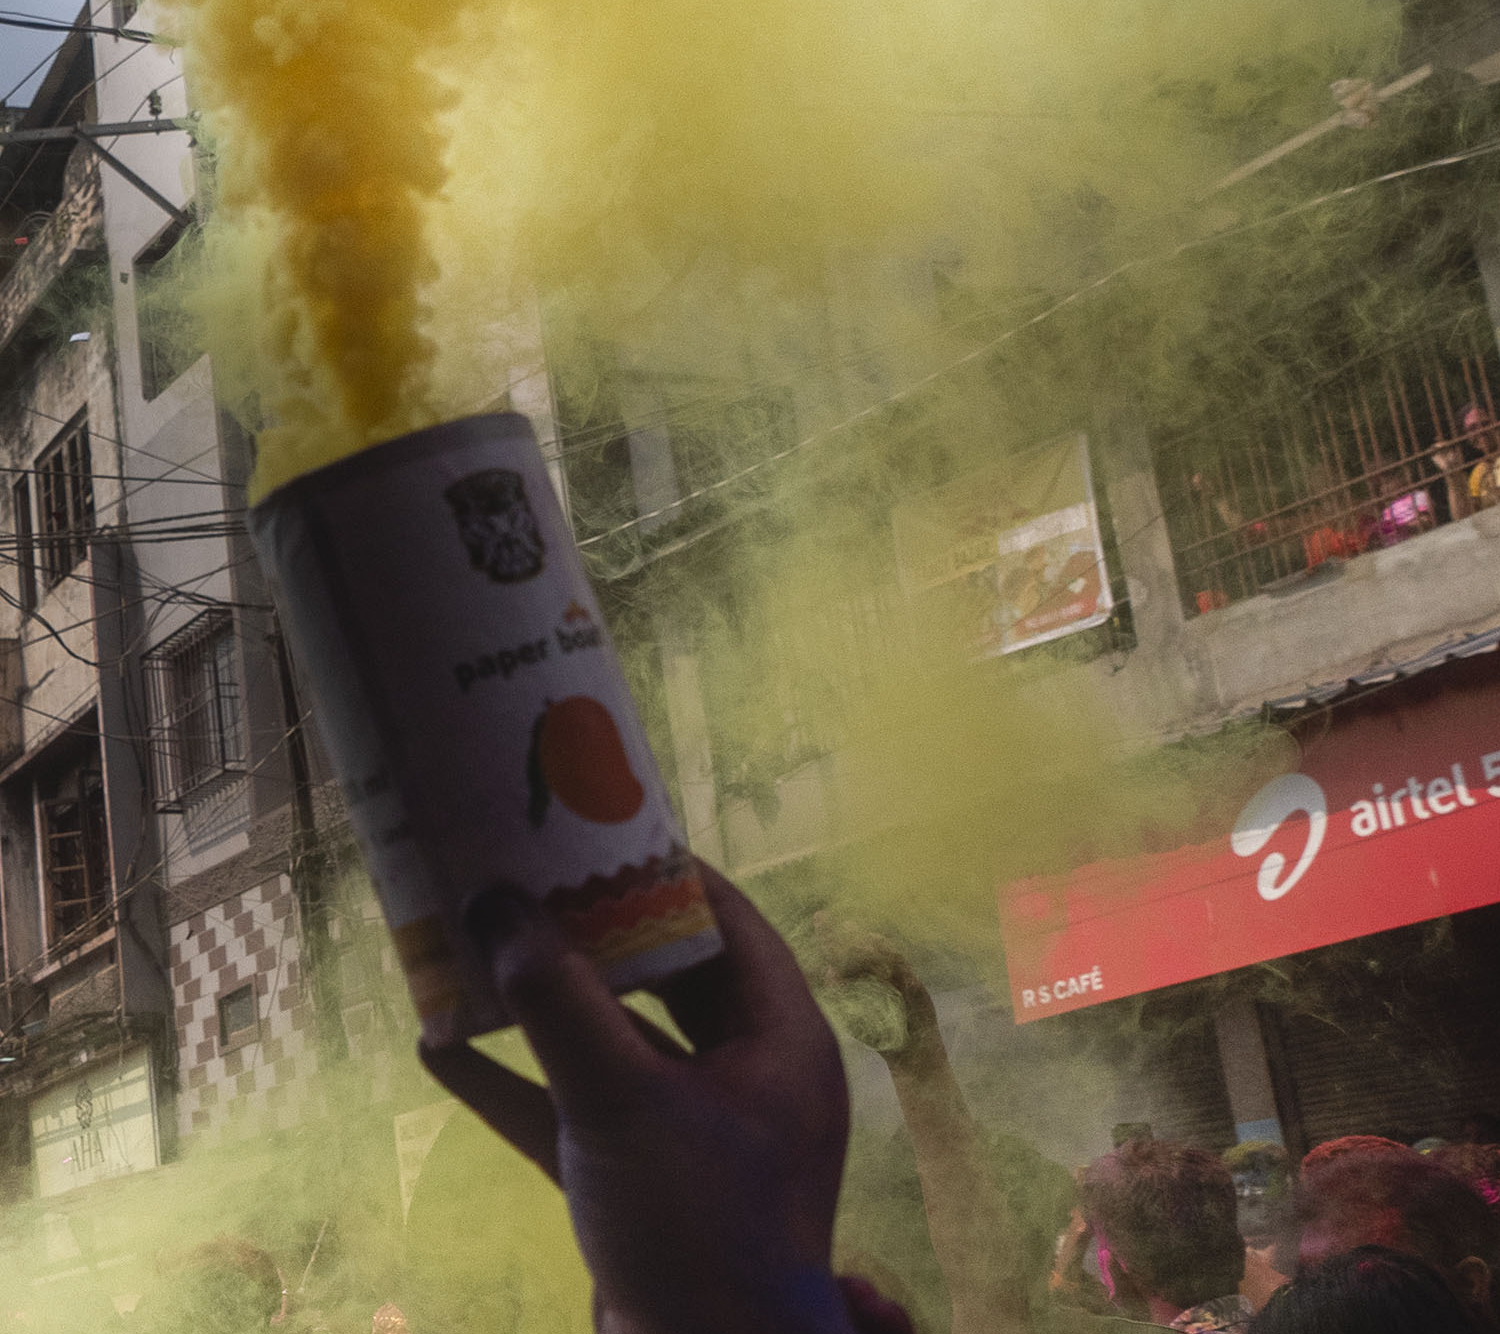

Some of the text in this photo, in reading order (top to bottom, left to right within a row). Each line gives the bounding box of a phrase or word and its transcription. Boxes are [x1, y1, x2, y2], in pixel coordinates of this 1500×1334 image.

[455, 638, 548, 692] paper
[1349, 763, 1477, 838] airtel
[1022, 965, 1105, 1008] R S CAFÉ
